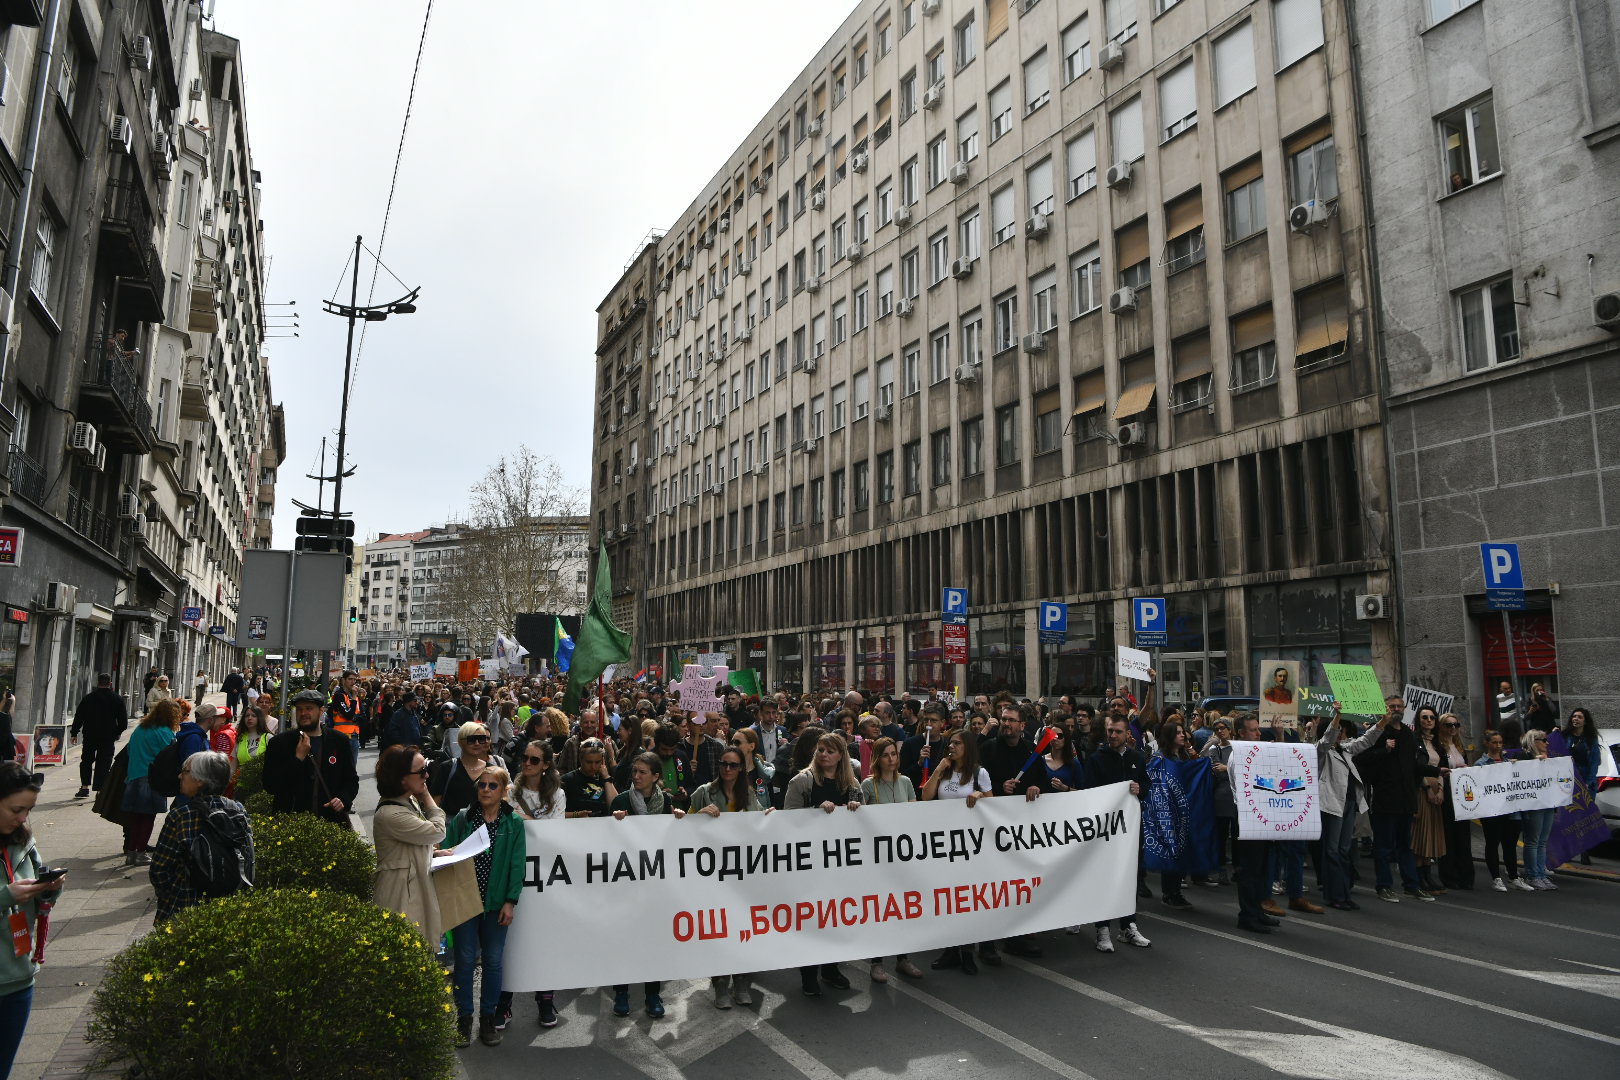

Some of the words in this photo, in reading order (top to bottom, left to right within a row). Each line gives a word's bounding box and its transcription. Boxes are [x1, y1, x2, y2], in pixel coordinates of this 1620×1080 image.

[1490, 549, 1512, 583] P
[948, 591, 961, 610] P
[1141, 602, 1159, 628] P
[1046, 605, 1061, 628] P
[1268, 798, 1294, 808] ПУЛС
[1275, 794, 1313, 832] ОСНОВНИХ
[523, 854, 572, 893] ДА
[586, 848, 666, 884] НАМ
[678, 841, 813, 882] ГОДИНЕ
[822, 837, 863, 869] НЕ
[874, 827, 985, 864] ПОЈЕДУ
[995, 809, 1128, 853] СКАКАВЦИ
[672, 907, 728, 942] ОШ
[739, 890, 923, 943] „БОРИСЛАВ
